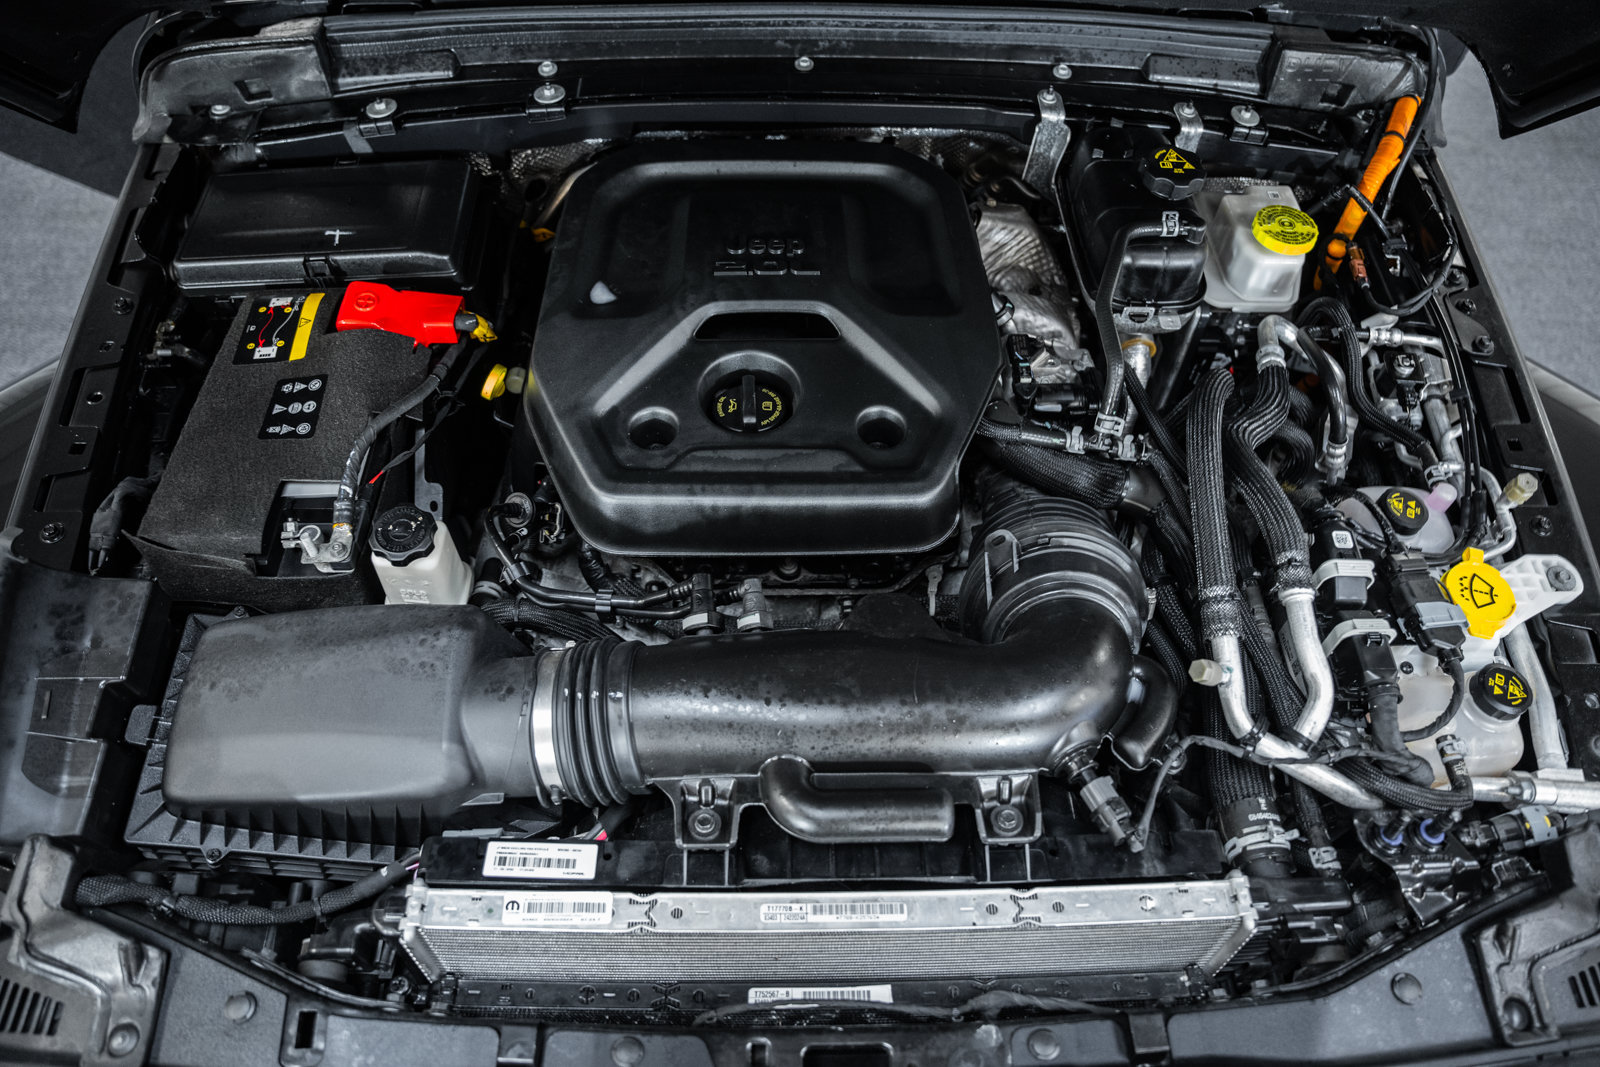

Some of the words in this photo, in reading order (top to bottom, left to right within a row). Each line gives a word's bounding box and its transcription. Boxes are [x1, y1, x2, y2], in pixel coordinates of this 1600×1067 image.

[726, 233, 805, 256] Jeep
[713, 260, 821, 276] 2.0L
[754, 990, 780, 998] T752567
